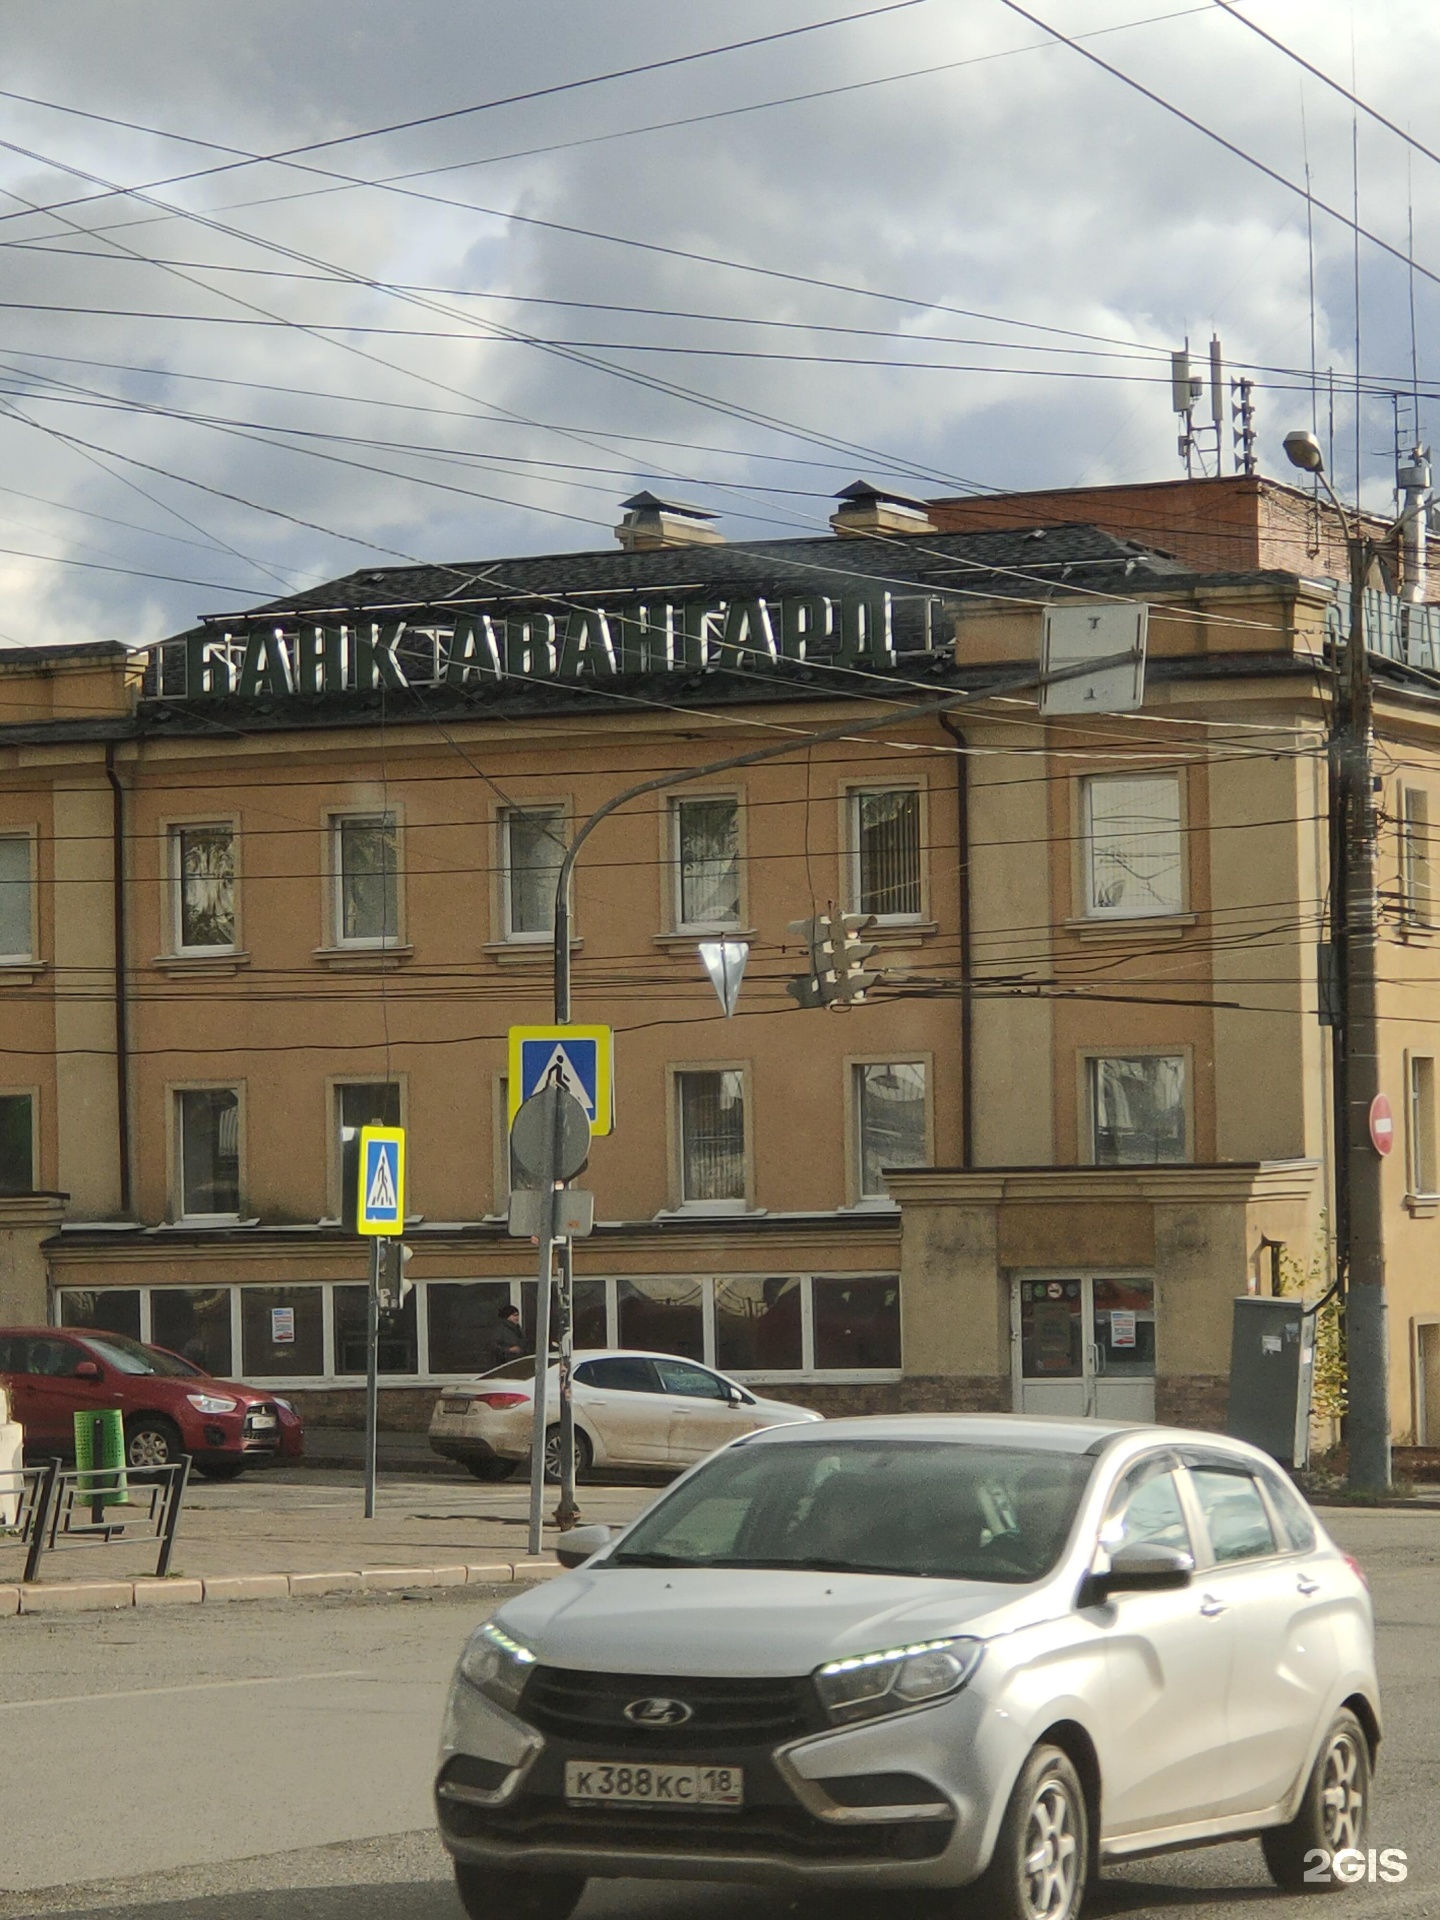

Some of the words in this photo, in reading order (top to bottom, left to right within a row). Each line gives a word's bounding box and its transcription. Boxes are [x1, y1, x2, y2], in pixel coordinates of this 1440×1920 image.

[187, 622, 408, 699] БАНК
[447, 591, 896, 681] АВАНГАРД
[576, 1766, 692, 1798] К388КС
[703, 1770, 732, 1791] 18
